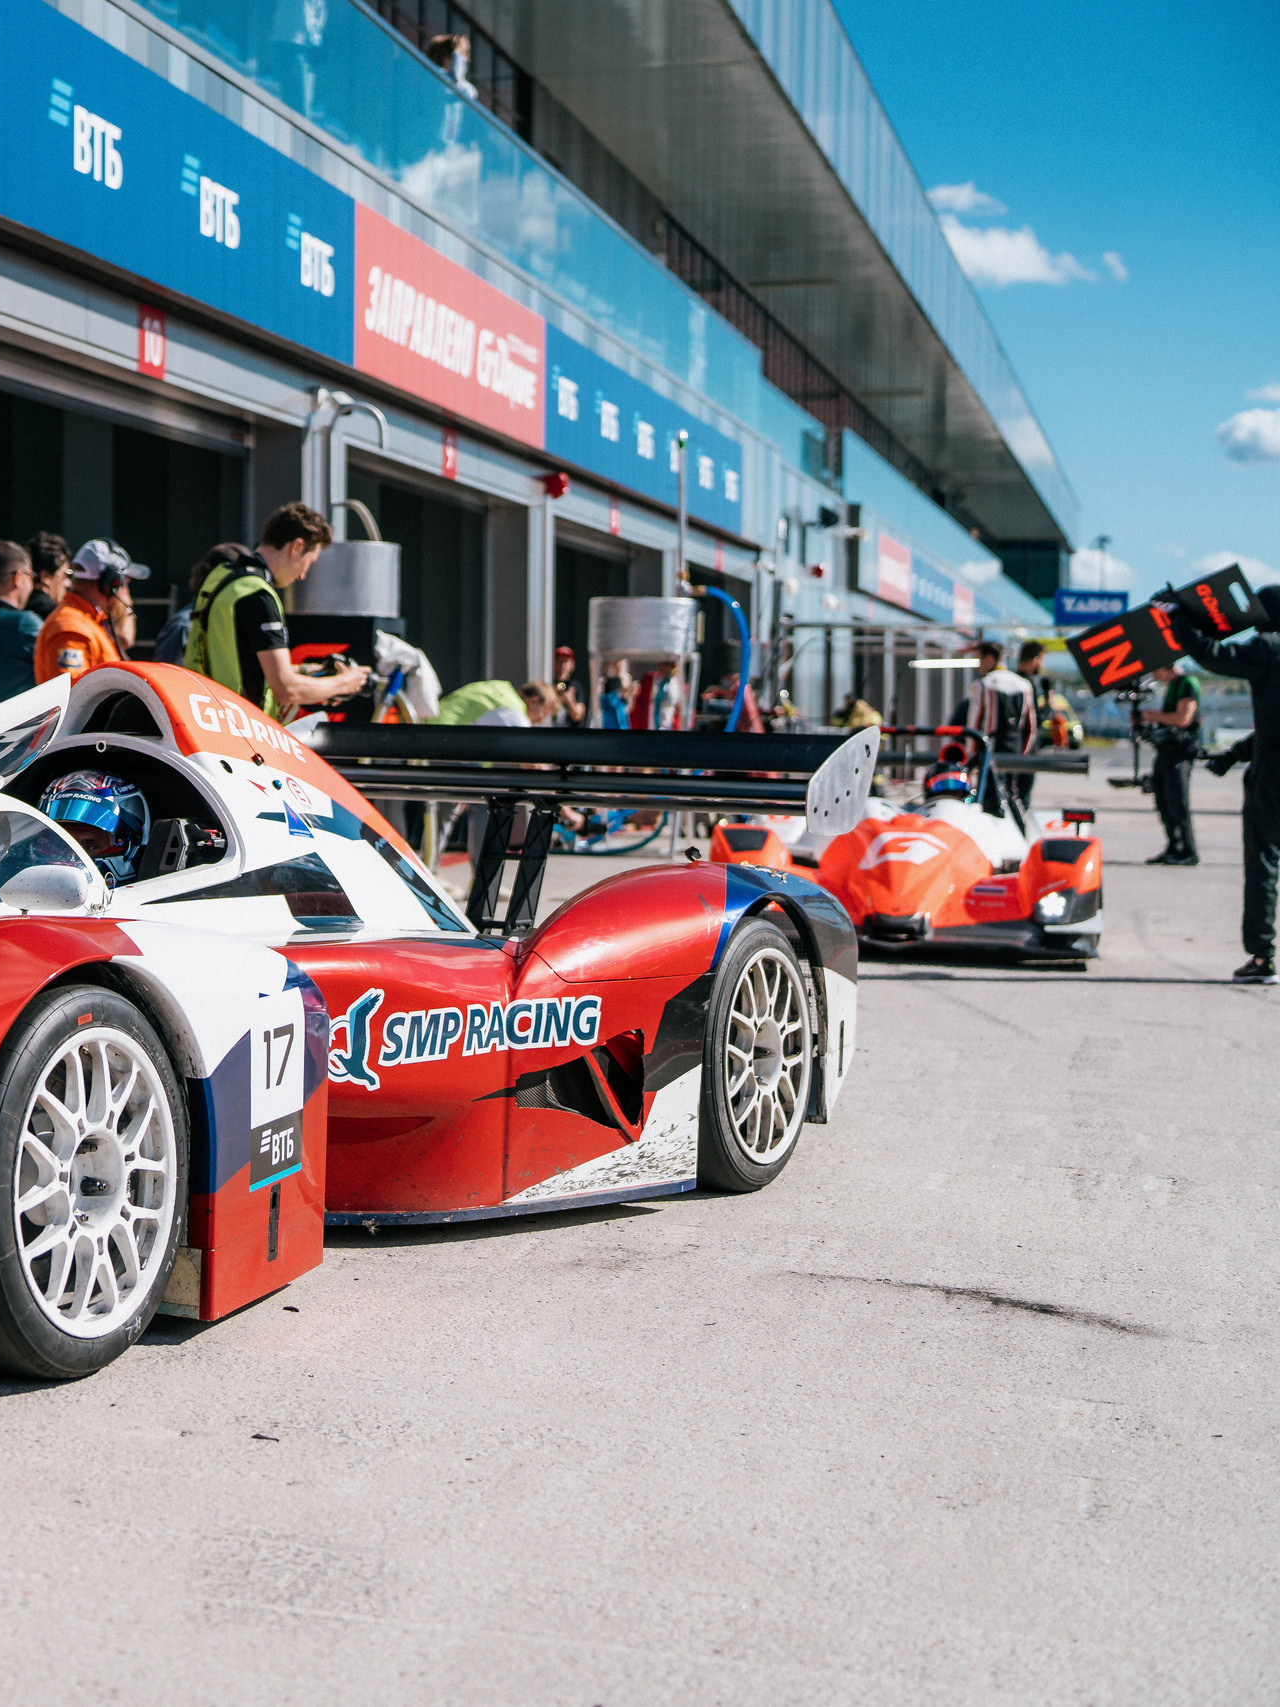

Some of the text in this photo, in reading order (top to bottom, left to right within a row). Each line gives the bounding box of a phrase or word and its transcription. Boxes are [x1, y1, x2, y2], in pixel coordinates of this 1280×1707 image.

[73, 104, 123, 190] ВТБ
[199, 175, 241, 250] ВТБ
[300, 231, 335, 297] ВТБ
[1078, 622, 1145, 688] IN
[73, 792, 102, 803] RACING
[263, 1022, 295, 1091] 17
[379, 996, 600, 1064] SMP RACING
[271, 1126, 295, 1167] ВТБ
